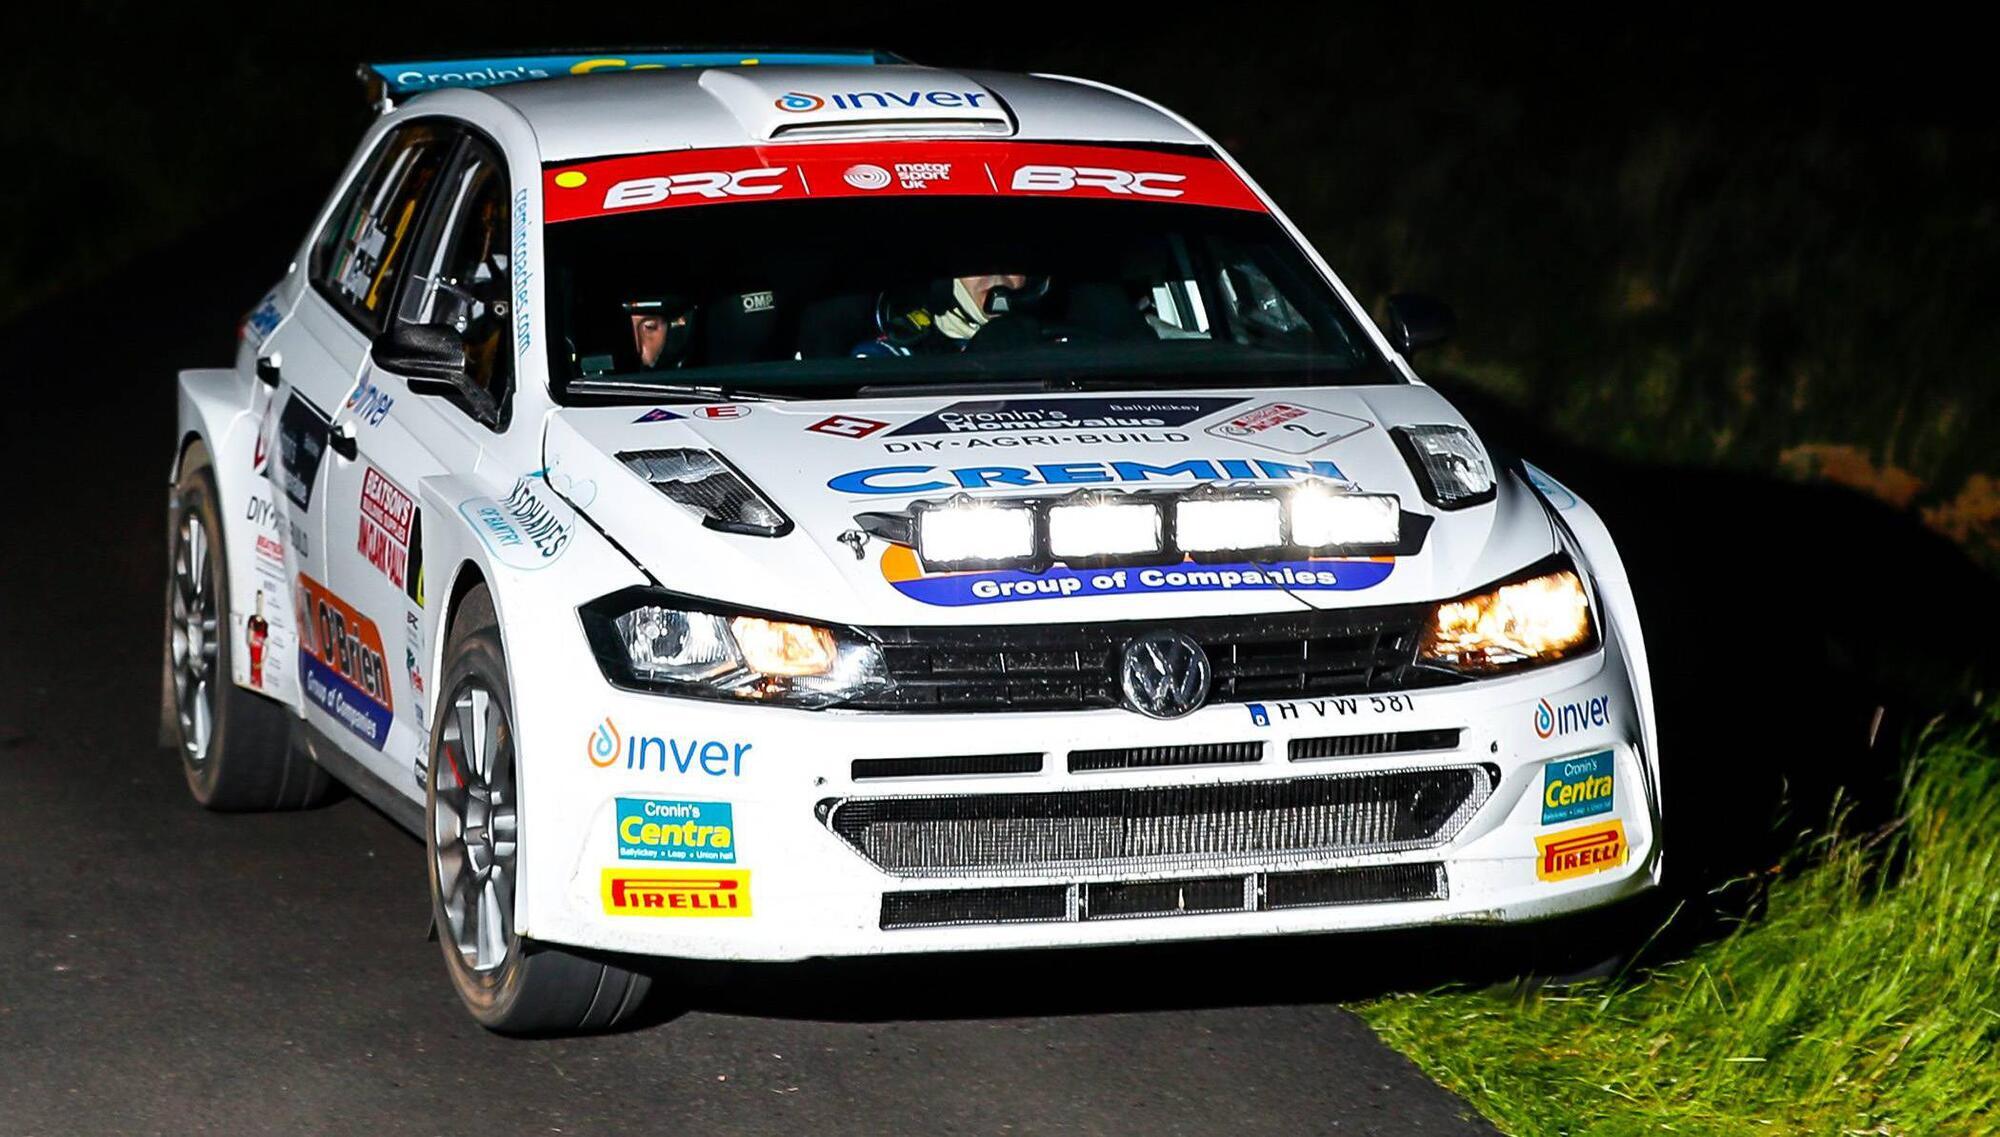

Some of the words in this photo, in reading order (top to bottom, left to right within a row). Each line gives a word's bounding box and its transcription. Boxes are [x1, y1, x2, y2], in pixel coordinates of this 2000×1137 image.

[833, 90, 986, 110] inver
[895, 163, 951, 172] motor
[898, 171, 950, 180] sport
[603, 167, 788, 210] BRC
[901, 180, 927, 188] UK
[1011, 165, 1186, 198] BRC
[743, 295, 773, 309] OMP
[705, 406, 739, 417] E
[938, 409, 1067, 422] Cronin's
[946, 418, 1164, 432] Homevalue
[826, 459, 1348, 494] CREMIN
[971, 578, 1081, 598] Group
[1091, 570, 1128, 589] of
[1138, 567, 1338, 591] Companies
[319, 598, 388, 706] O'Brien
[1277, 703, 1299, 719] H
[1308, 699, 1357, 717] VW
[1557, 694, 1610, 735] inver
[627, 736, 752, 776] inver
[1565, 758, 1598, 777] Cronin's
[1546, 775, 1612, 808] Centra
[644, 802, 700, 818] Cronin's
[619, 816, 731, 847] Centra
[1544, 830, 1619, 873] PIRELLI
[612, 879, 738, 908] PIRELLI
